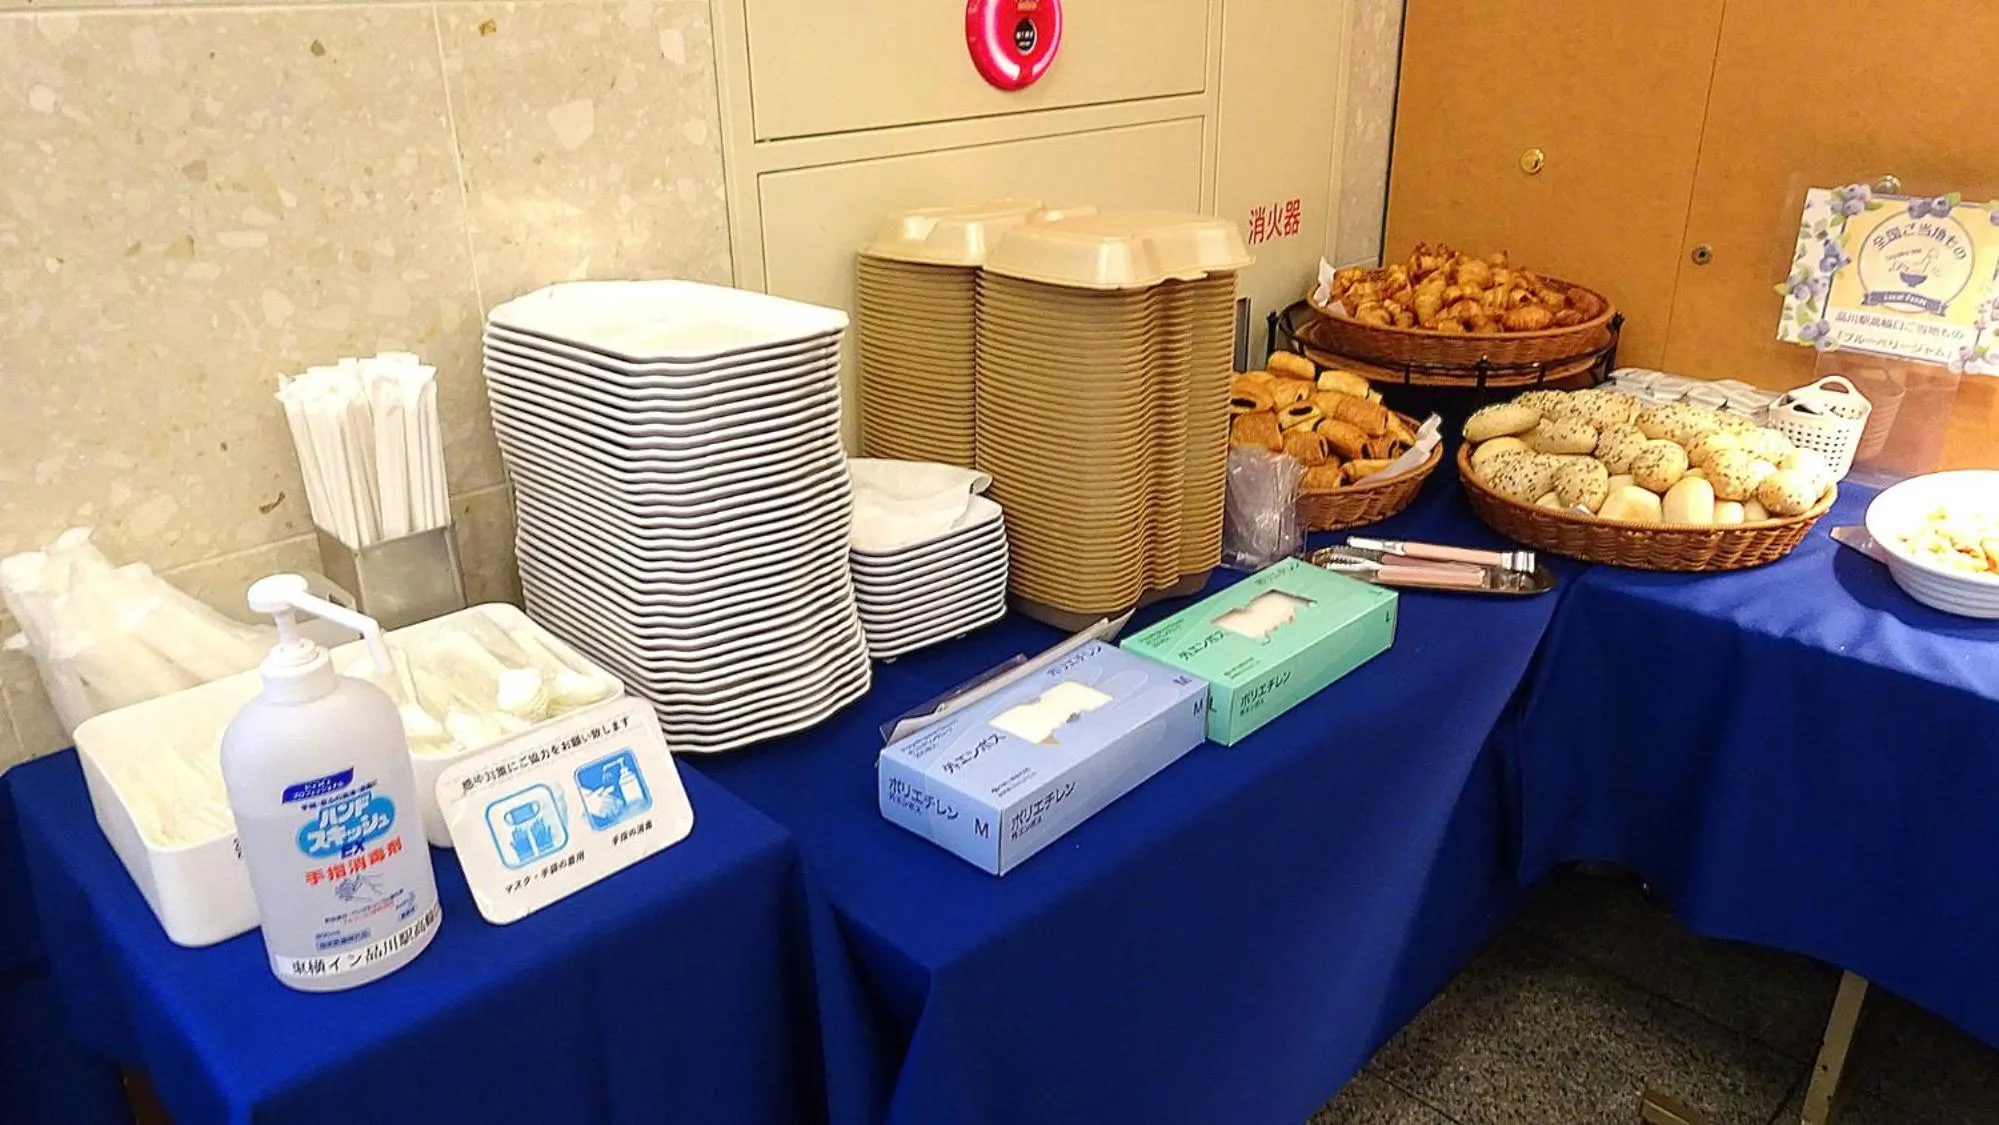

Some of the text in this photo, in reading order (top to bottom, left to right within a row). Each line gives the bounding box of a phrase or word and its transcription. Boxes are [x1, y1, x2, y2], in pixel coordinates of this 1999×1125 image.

[1248, 199, 1301, 245] 消火器
[1873, 222, 1967, 260] 全国ご当地もの
[1193, 698, 1203, 716] M
[1239, 671, 1291, 707] ポリエチレン
[317, 790, 373, 829] ハンド
[888, 777, 959, 820] ポリエチレン
[1010, 781, 1076, 831] ポリエチレン
[307, 812, 391, 853] スキッシュ
[612, 820, 653, 847] 手指の消毒
[974, 817, 989, 839] M
[305, 837, 403, 887] 手指消毒剤
[340, 841, 366, 859] EX
[505, 849, 585, 894] マスク・手袋の着用
[292, 903, 437, 975] 東横イン品川駅高輪
